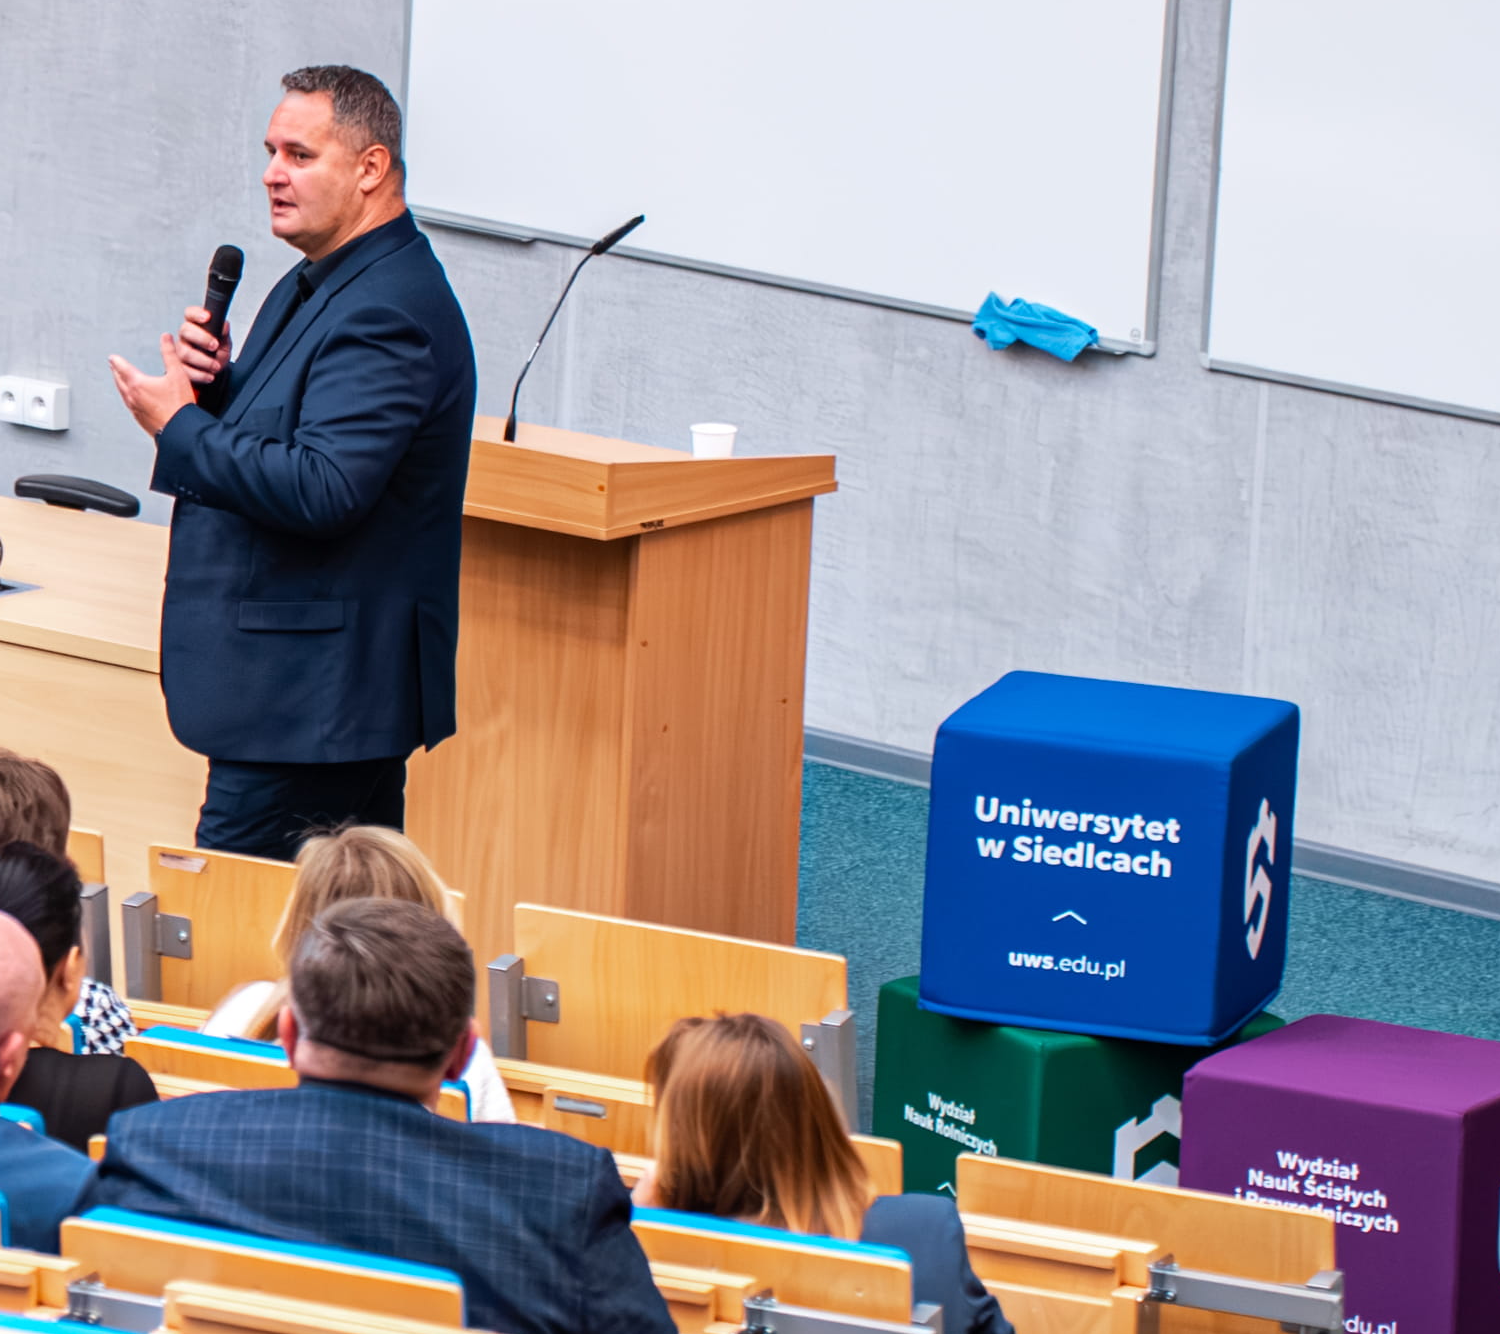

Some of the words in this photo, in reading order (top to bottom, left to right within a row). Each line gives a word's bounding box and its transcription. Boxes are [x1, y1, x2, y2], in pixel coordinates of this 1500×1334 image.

[974, 795, 1181, 844] Uniwersytet
[976, 836, 1006, 859] w
[1011, 835, 1173, 878] Siedlcach
[1008, 951, 1126, 981] uws.edu.pl
[927, 1091, 976, 1125] Wydział
[904, 1103, 934, 1131] Nauk
[935, 1117, 998, 1157] Rolniczych
[1276, 1150, 1360, 1181] Wydział
[1248, 1169, 1300, 1193] Nauk
[1303, 1175, 1387, 1208] Ścisłych
